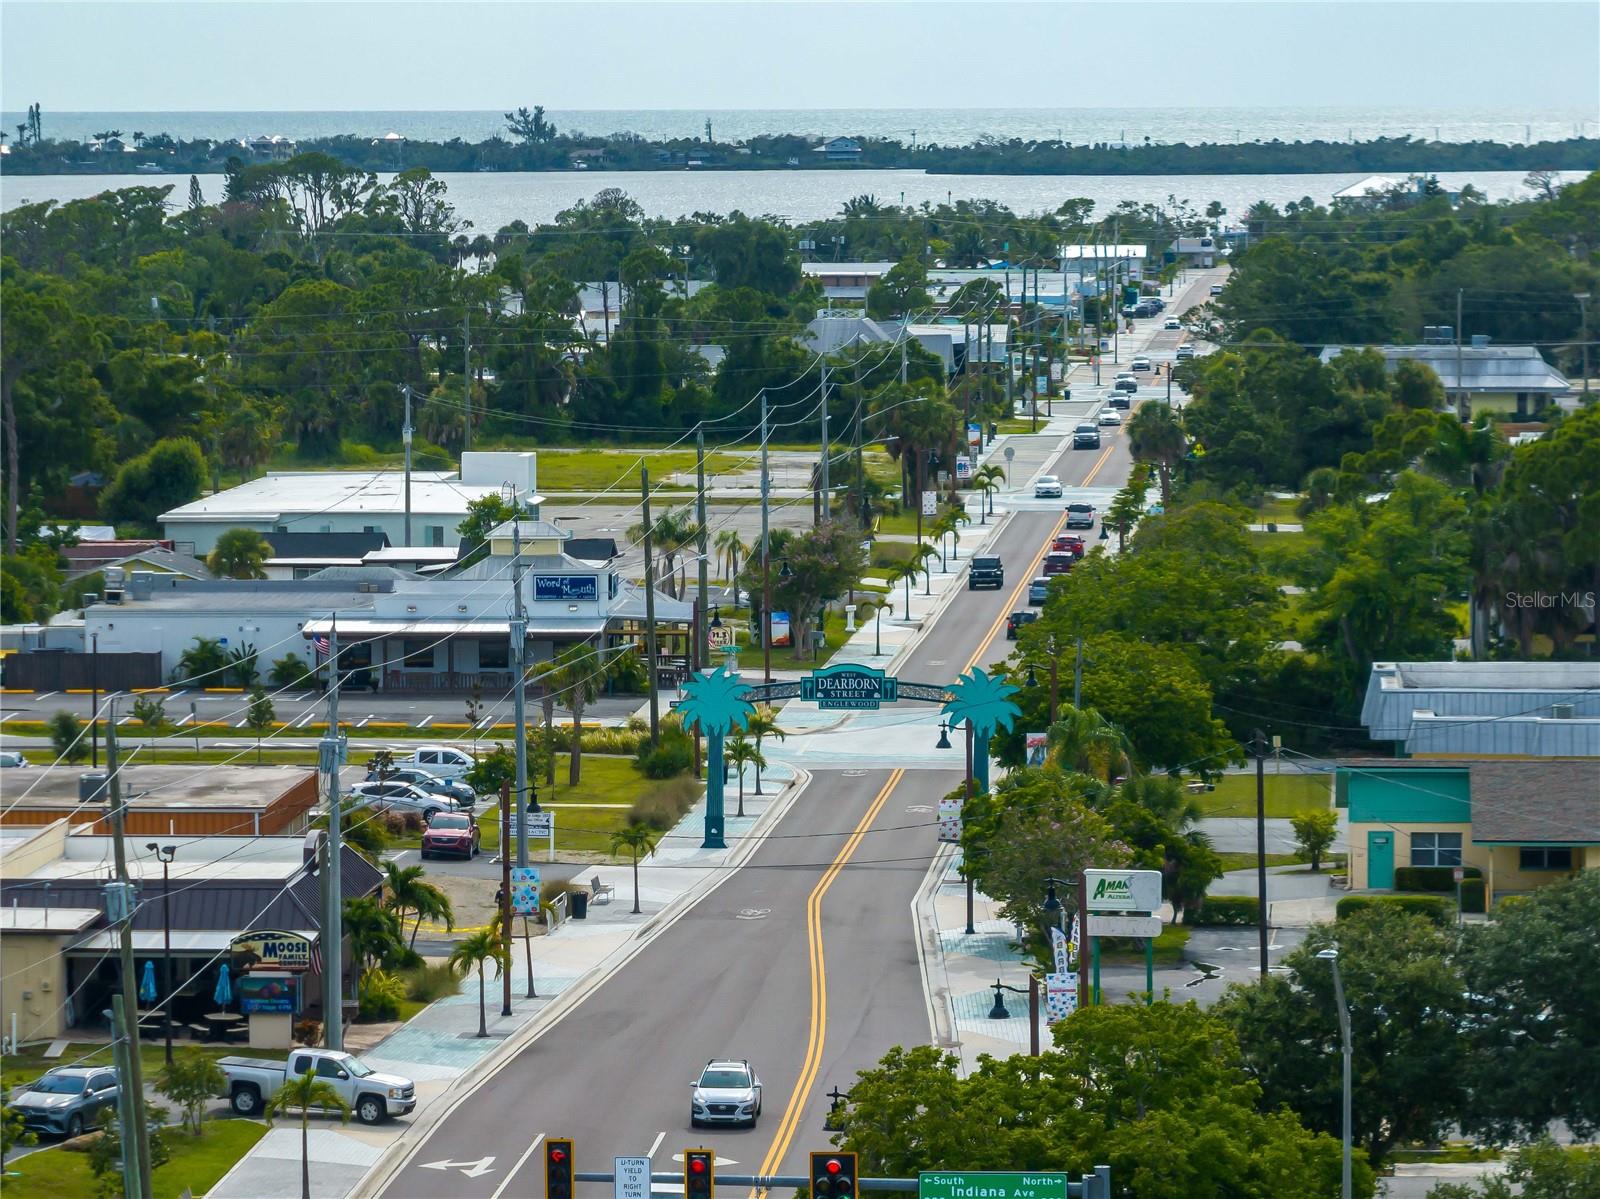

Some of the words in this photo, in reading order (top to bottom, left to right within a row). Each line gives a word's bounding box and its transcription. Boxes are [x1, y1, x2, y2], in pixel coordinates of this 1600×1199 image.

[537, 578, 561, 588] Word
[818, 678, 879, 689] DEARBORN
[830, 690, 866, 698] STREET
[262, 942, 307, 958] MOOSE
[933, 1176, 964, 1185] South
[1022, 1176, 1053, 1186] North
[951, 1186, 1006, 1197] Indiana
[1014, 1188, 1035, 1197] Ave
